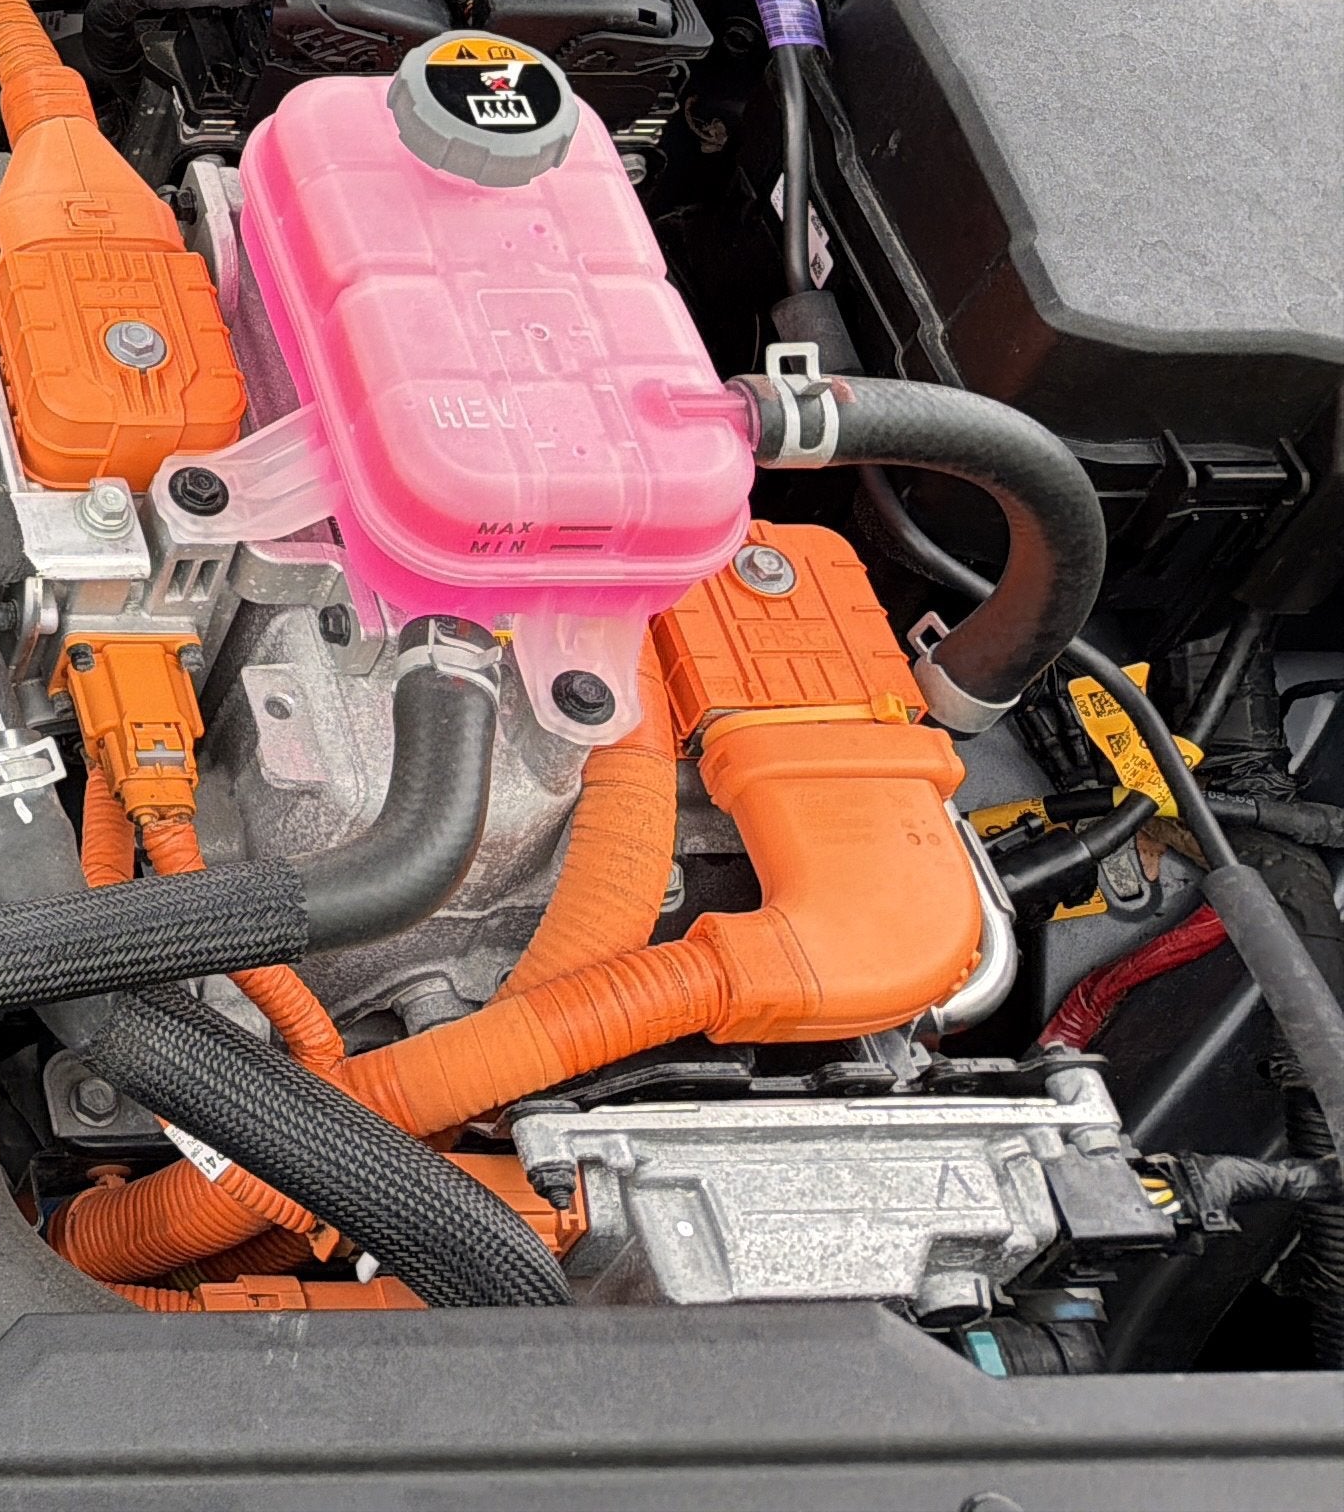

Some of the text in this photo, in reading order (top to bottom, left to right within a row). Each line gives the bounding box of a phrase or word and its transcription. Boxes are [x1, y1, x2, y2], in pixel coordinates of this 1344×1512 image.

[428, 395, 516, 430] HEV
[477, 521, 535, 535] MAX
[469, 540, 526, 554] MIN
[1074, 693, 1091, 718] LOOP
